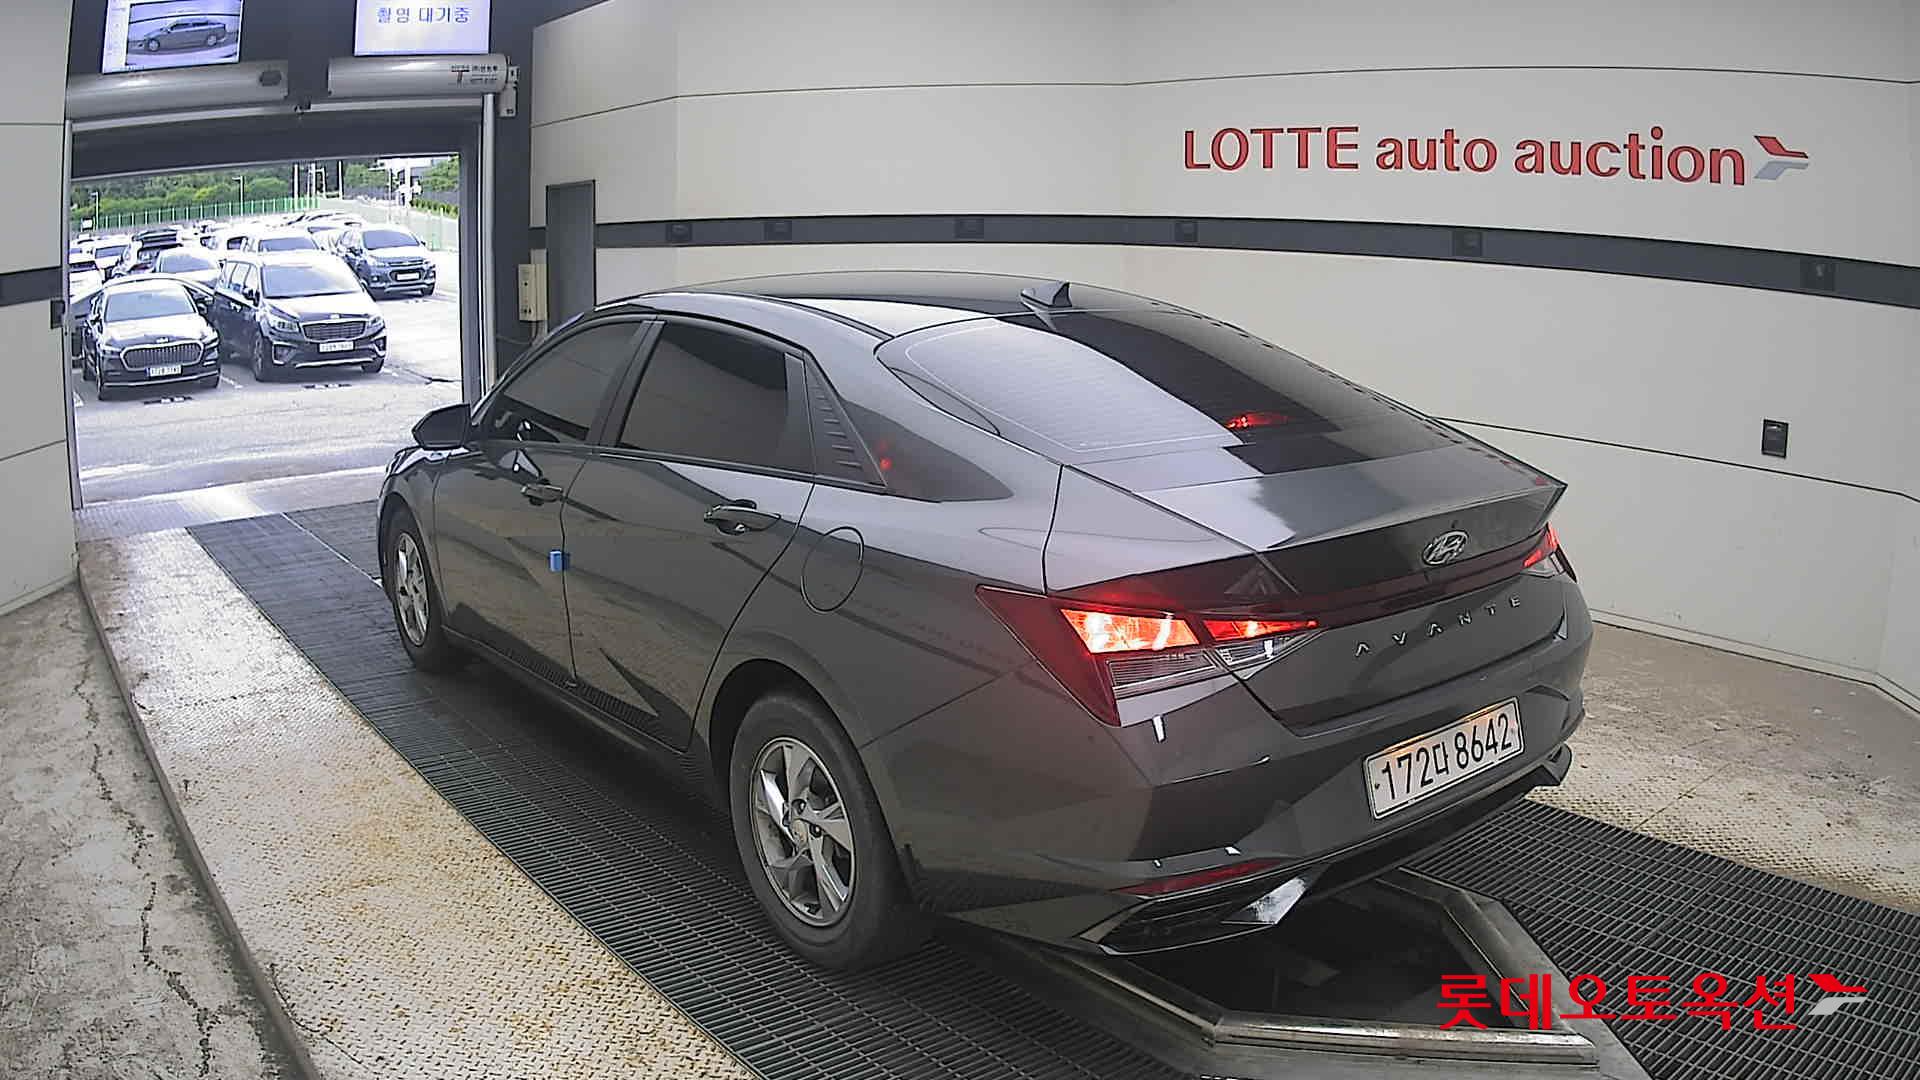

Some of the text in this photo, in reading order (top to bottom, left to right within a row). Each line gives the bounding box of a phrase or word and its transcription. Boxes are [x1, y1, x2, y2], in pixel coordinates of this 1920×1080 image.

[418, 6, 472, 24] 대기중
[1184, 126, 1745, 186] LOTTE auto auction
[1354, 595, 1522, 657] AVANTE
[1453, 712, 1513, 770] 8642
